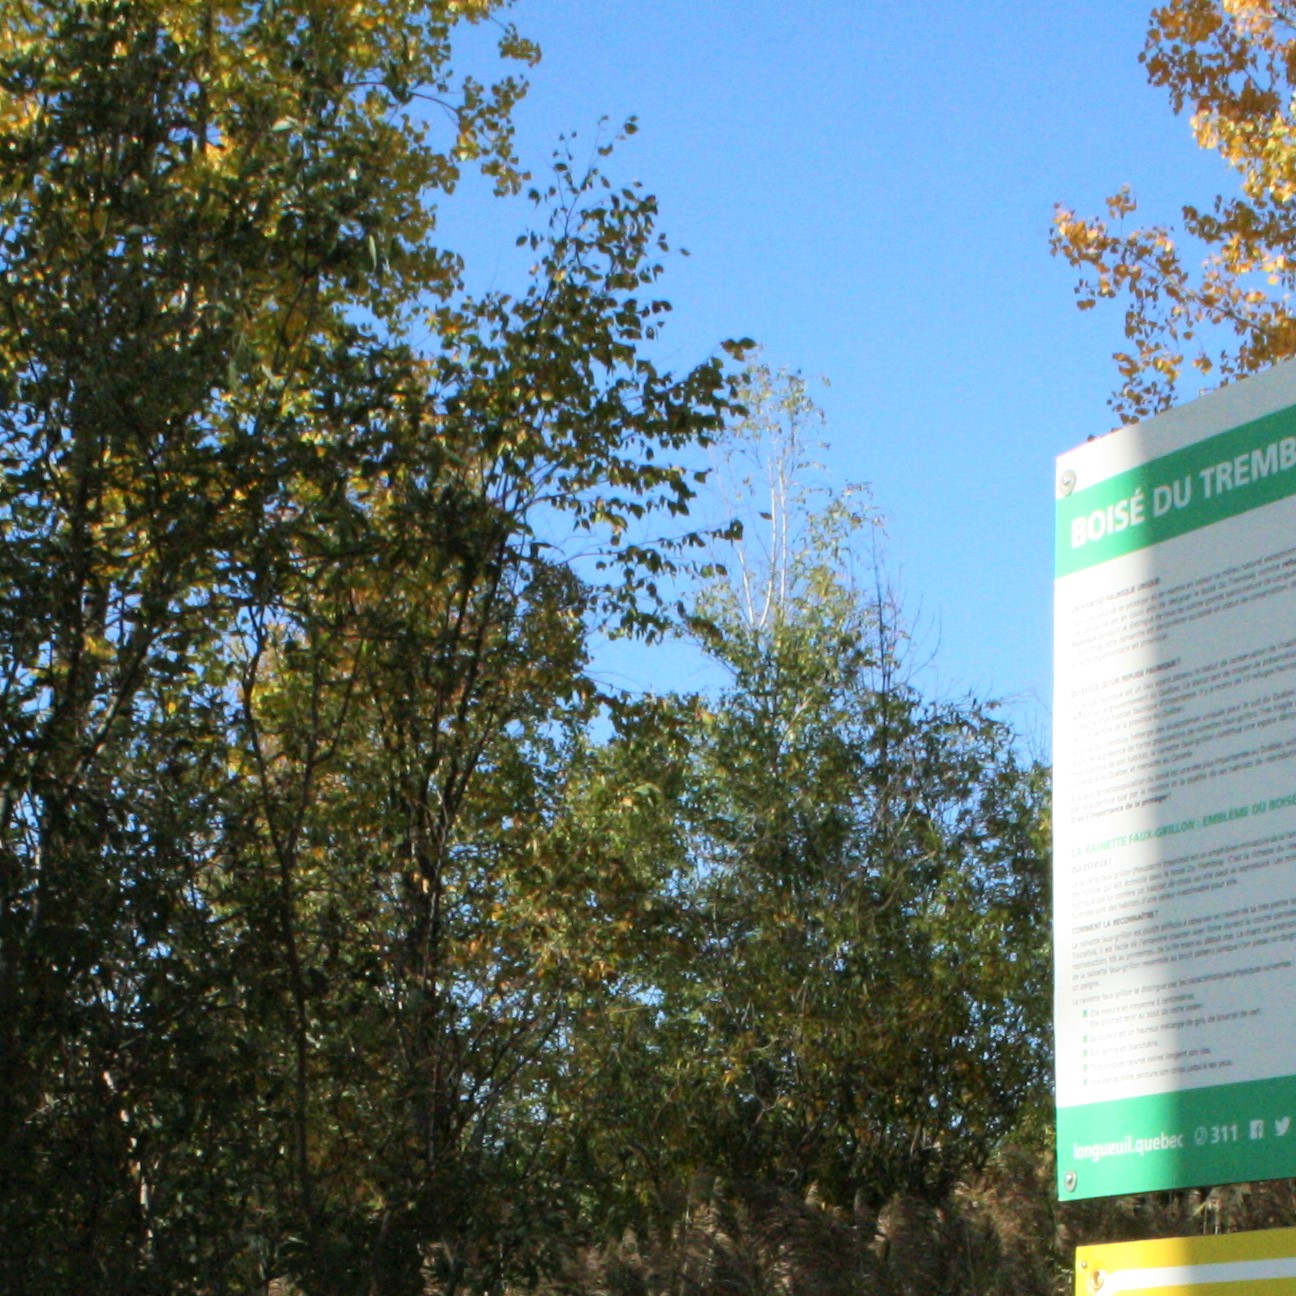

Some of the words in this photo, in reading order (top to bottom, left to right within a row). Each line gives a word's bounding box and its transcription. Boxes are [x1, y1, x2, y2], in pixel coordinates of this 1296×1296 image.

[1070, 487, 1144, 549] BOISÉ
[1153, 474, 1191, 519] DU
[1072, 1131, 1184, 1162] longueuil.quebec
[1209, 1124, 1238, 1144] 311
